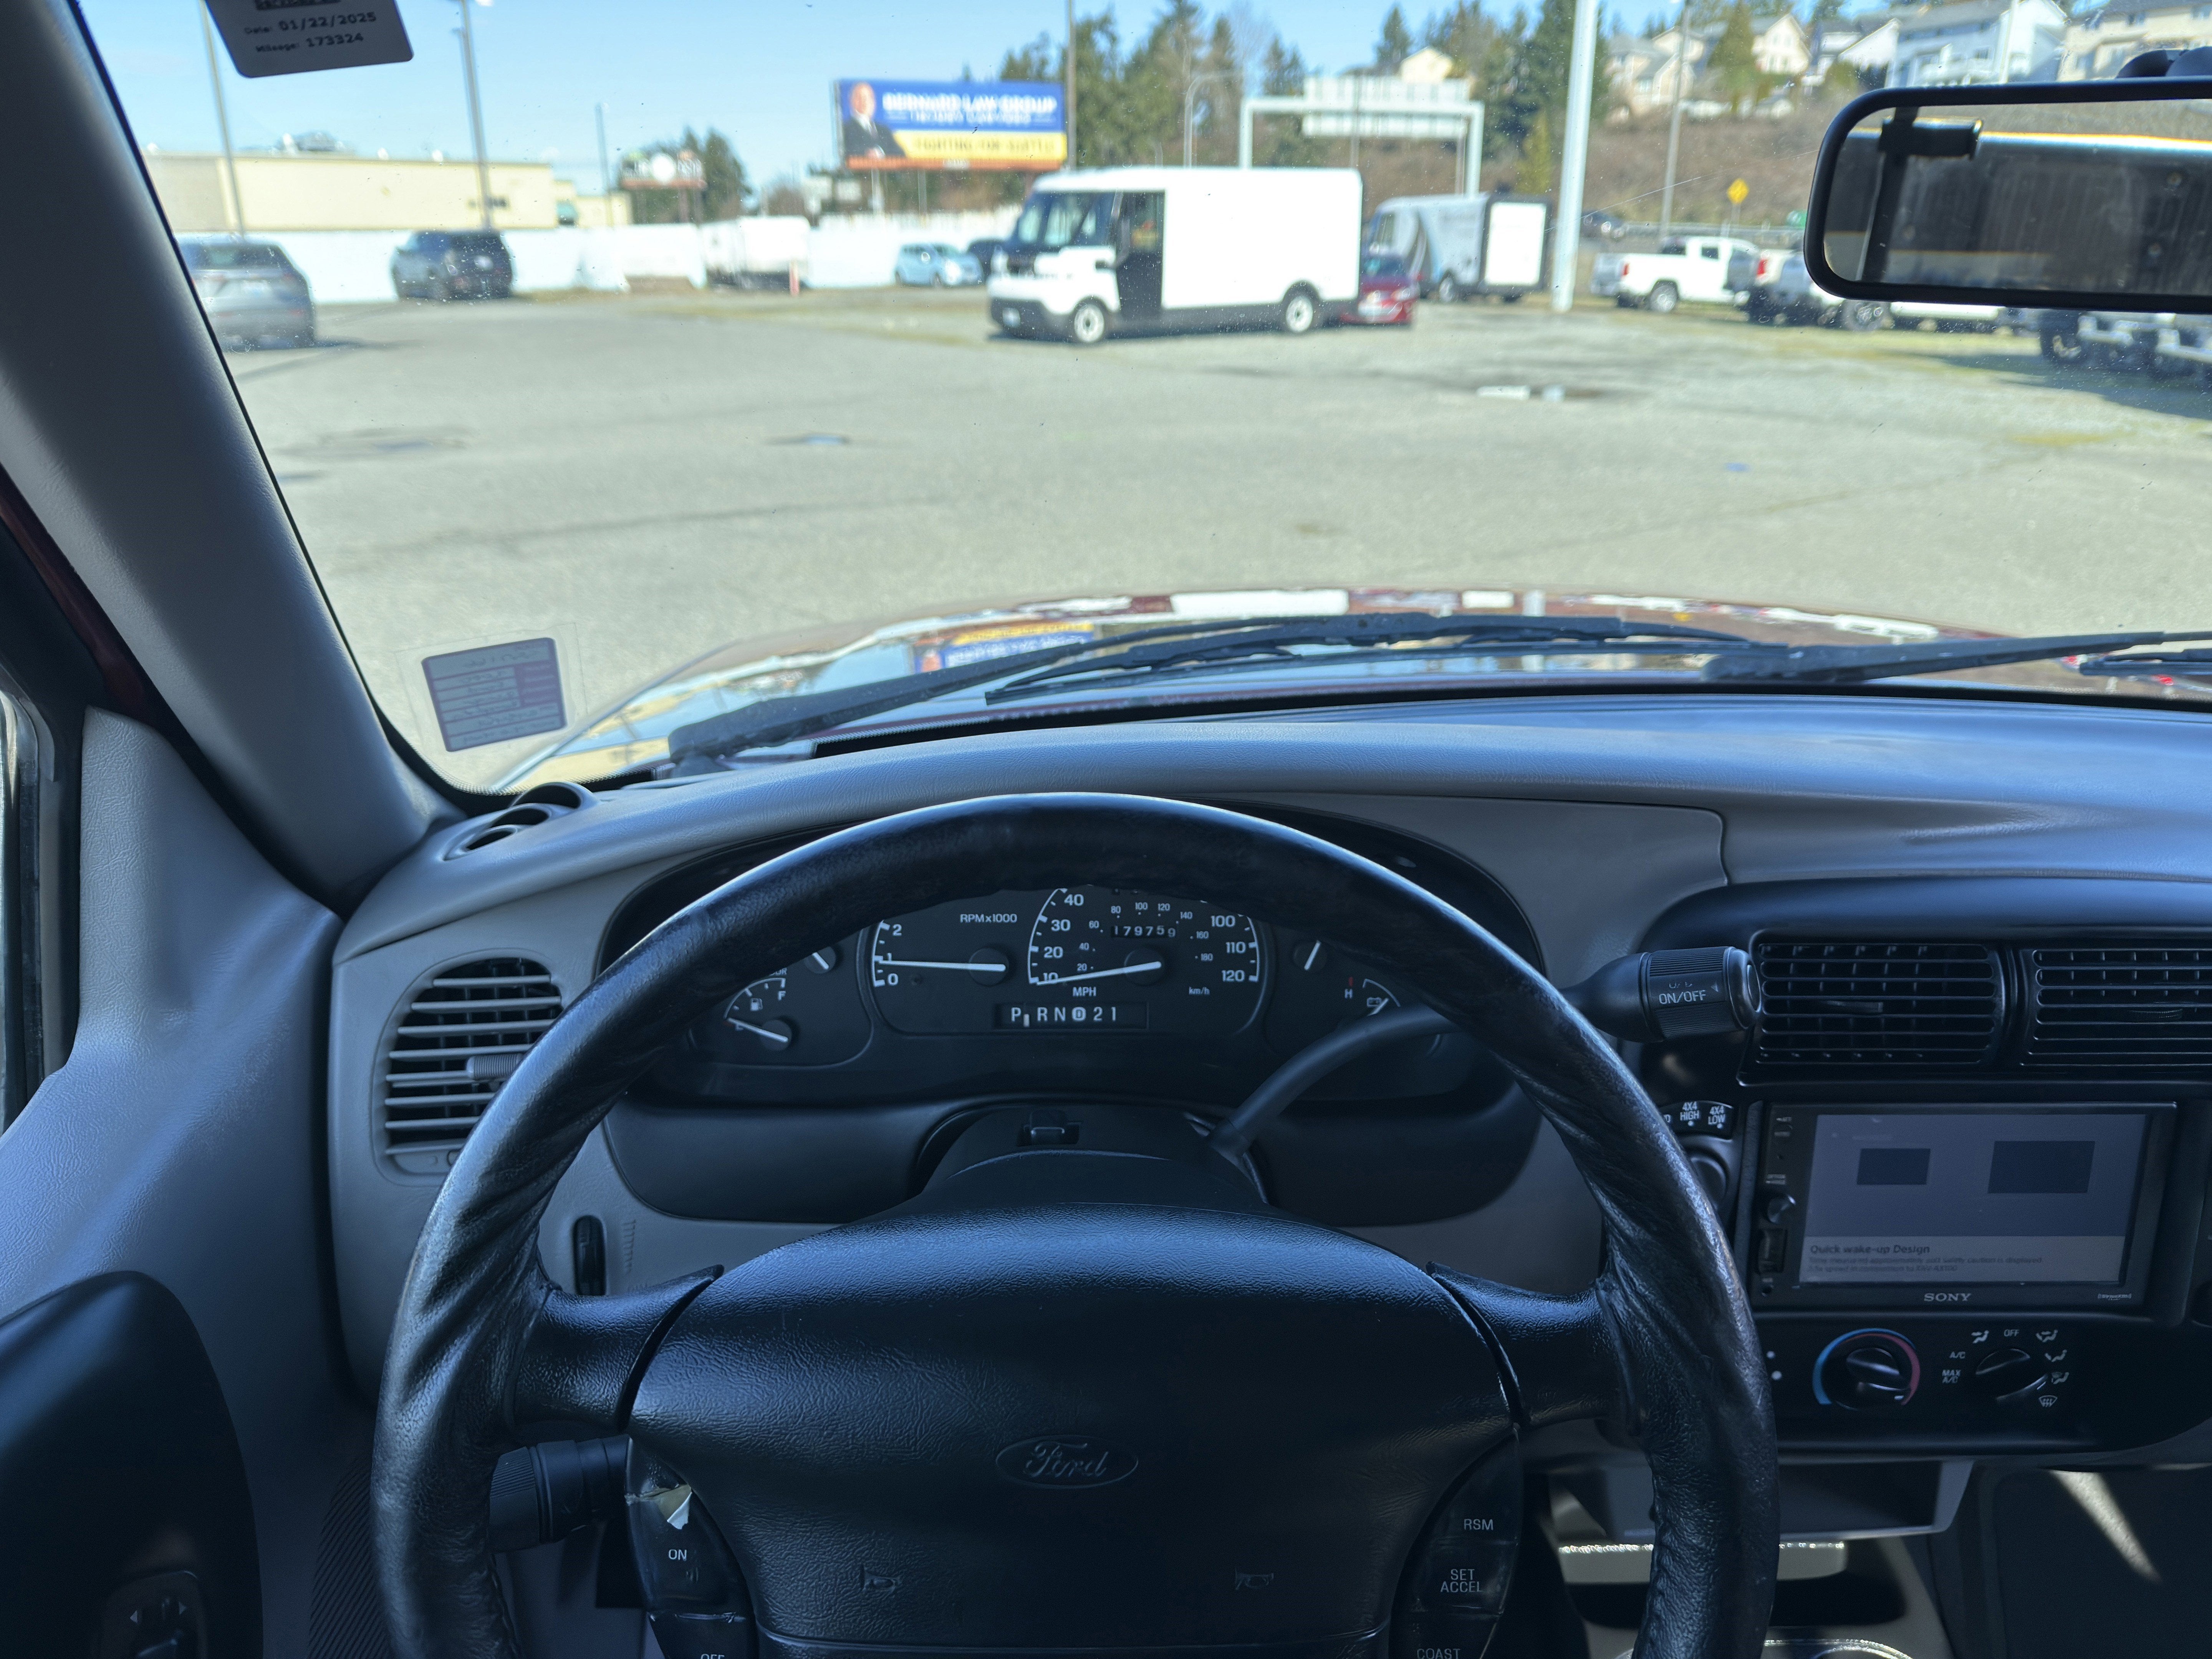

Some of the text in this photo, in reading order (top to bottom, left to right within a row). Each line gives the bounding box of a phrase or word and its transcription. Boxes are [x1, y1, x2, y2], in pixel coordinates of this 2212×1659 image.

[278, 12, 376, 31] 01/22/2025
[305, 33, 364, 47] 173324
[1064, 894, 1084, 906] 40
[1135, 902, 1148, 910] 100
[1111, 906, 1121, 914] 80
[1158, 903, 1171, 912] 120
[960, 913, 1017, 923] RPMx1000
[1180, 911, 1193, 919] 140
[1211, 915, 1235, 927] 100
[892, 924, 902, 936] 2
[1051, 919, 1071, 931] 30
[1089, 921, 1099, 929] 60
[1114, 925, 1176, 937] 179759
[1079, 942, 1089, 950] 40
[1225, 941, 1246, 954] 110
[1043, 946, 1063, 959] 20
[1077, 963, 1087, 972] 20
[887, 973, 899, 986] 0
[1221, 970, 1245, 982] 120
[778, 990, 786, 1001] F
[1073, 987, 1096, 997] MPH
[1189, 987, 1210, 995] km/h
[1345, 988, 1353, 998] H
[1659, 990, 1706, 1005] ON/OFF
[1011, 1007, 1022, 1022] P
[1037, 1007, 1048, 1022] R
[1054, 1007, 1066, 1022] N
[1093, 1007, 1103, 1022] 2
[1111, 1007, 1116, 1022] 1
[1680, 1111, 1700, 1121] HIGH
[1708, 1114, 1726, 1125] LOW
[1810, 1245, 1930, 1255] Quick wake-up Design
[1924, 1293, 1971, 1302] SONY
[1023, 1441, 1109, 1478] Ford
[1464, 1518, 1493, 1531] RSM
[668, 1549, 687, 1561] ON
[1450, 1569, 1475, 1581] SET
[1440, 1581, 1483, 1593] ACCEL
[1417, 1648, 1461, 1659] COAST
